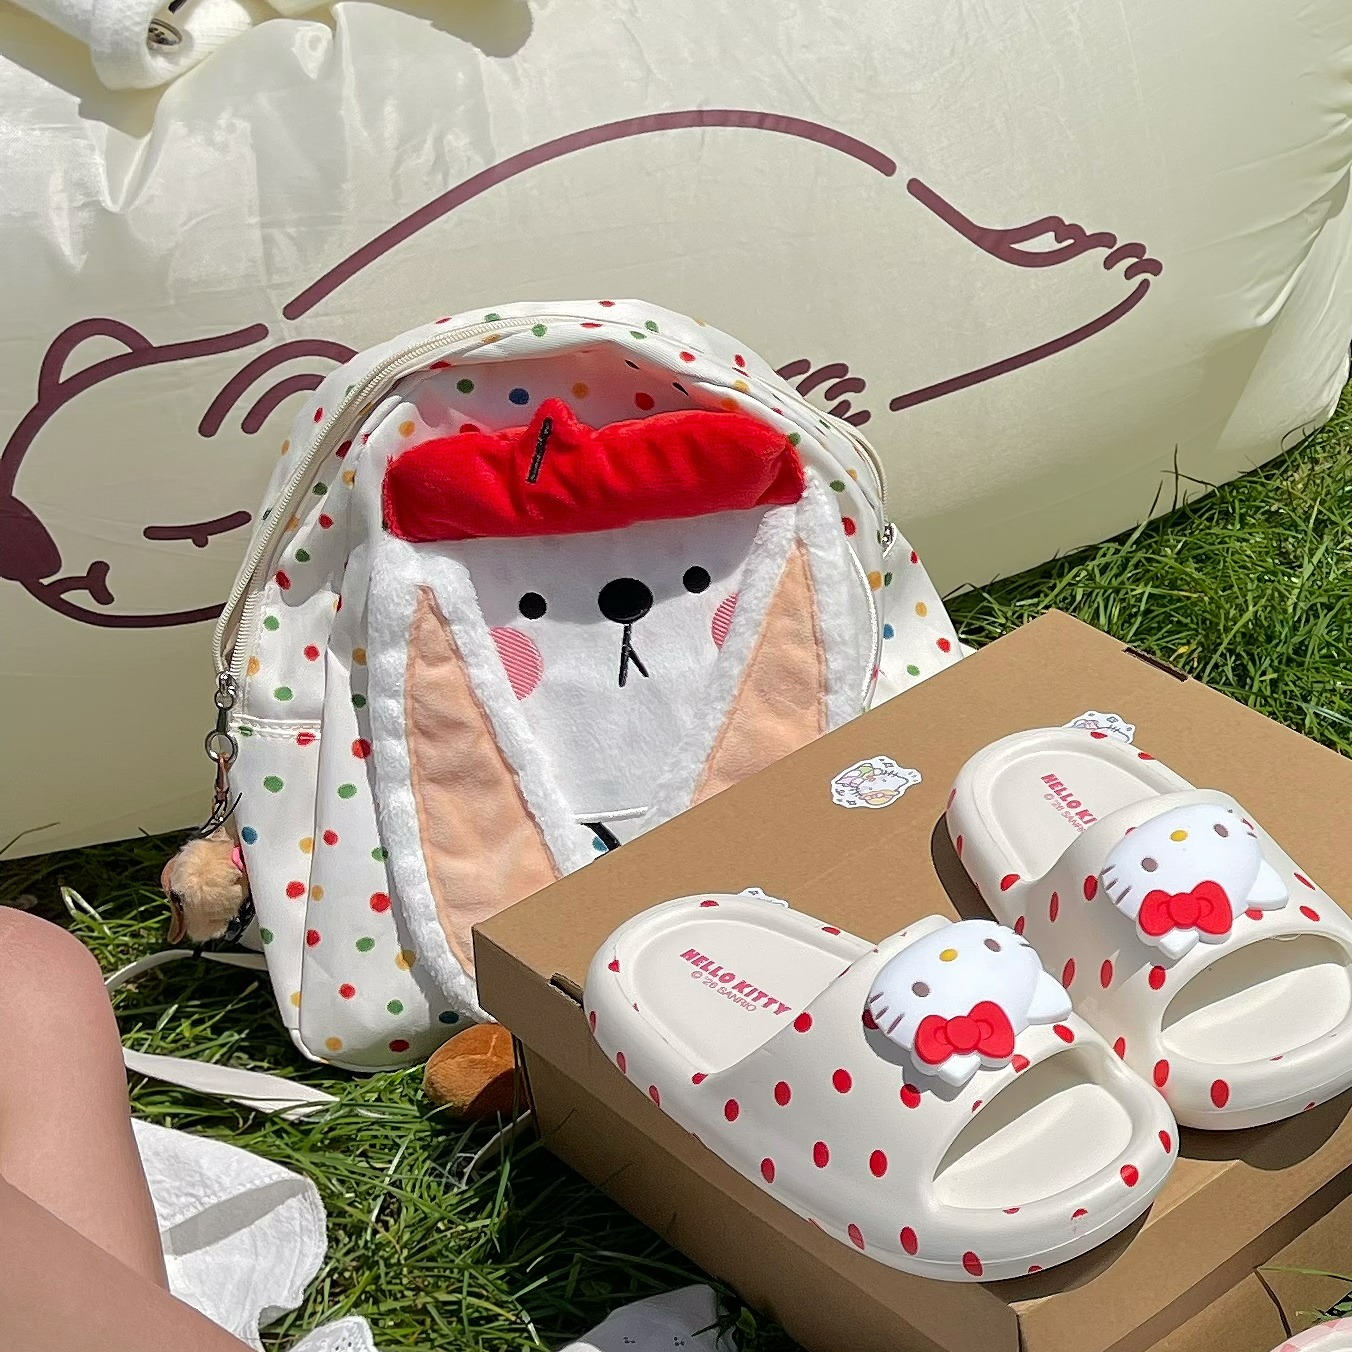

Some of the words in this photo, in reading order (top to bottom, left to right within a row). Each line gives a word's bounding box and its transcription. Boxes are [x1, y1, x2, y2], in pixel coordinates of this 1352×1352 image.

[1041, 774, 1081, 809] HELLO
[680, 948, 736, 984] HELLO
[732, 980, 792, 1016] KITTY
[717, 986, 757, 1012] SANRIO
